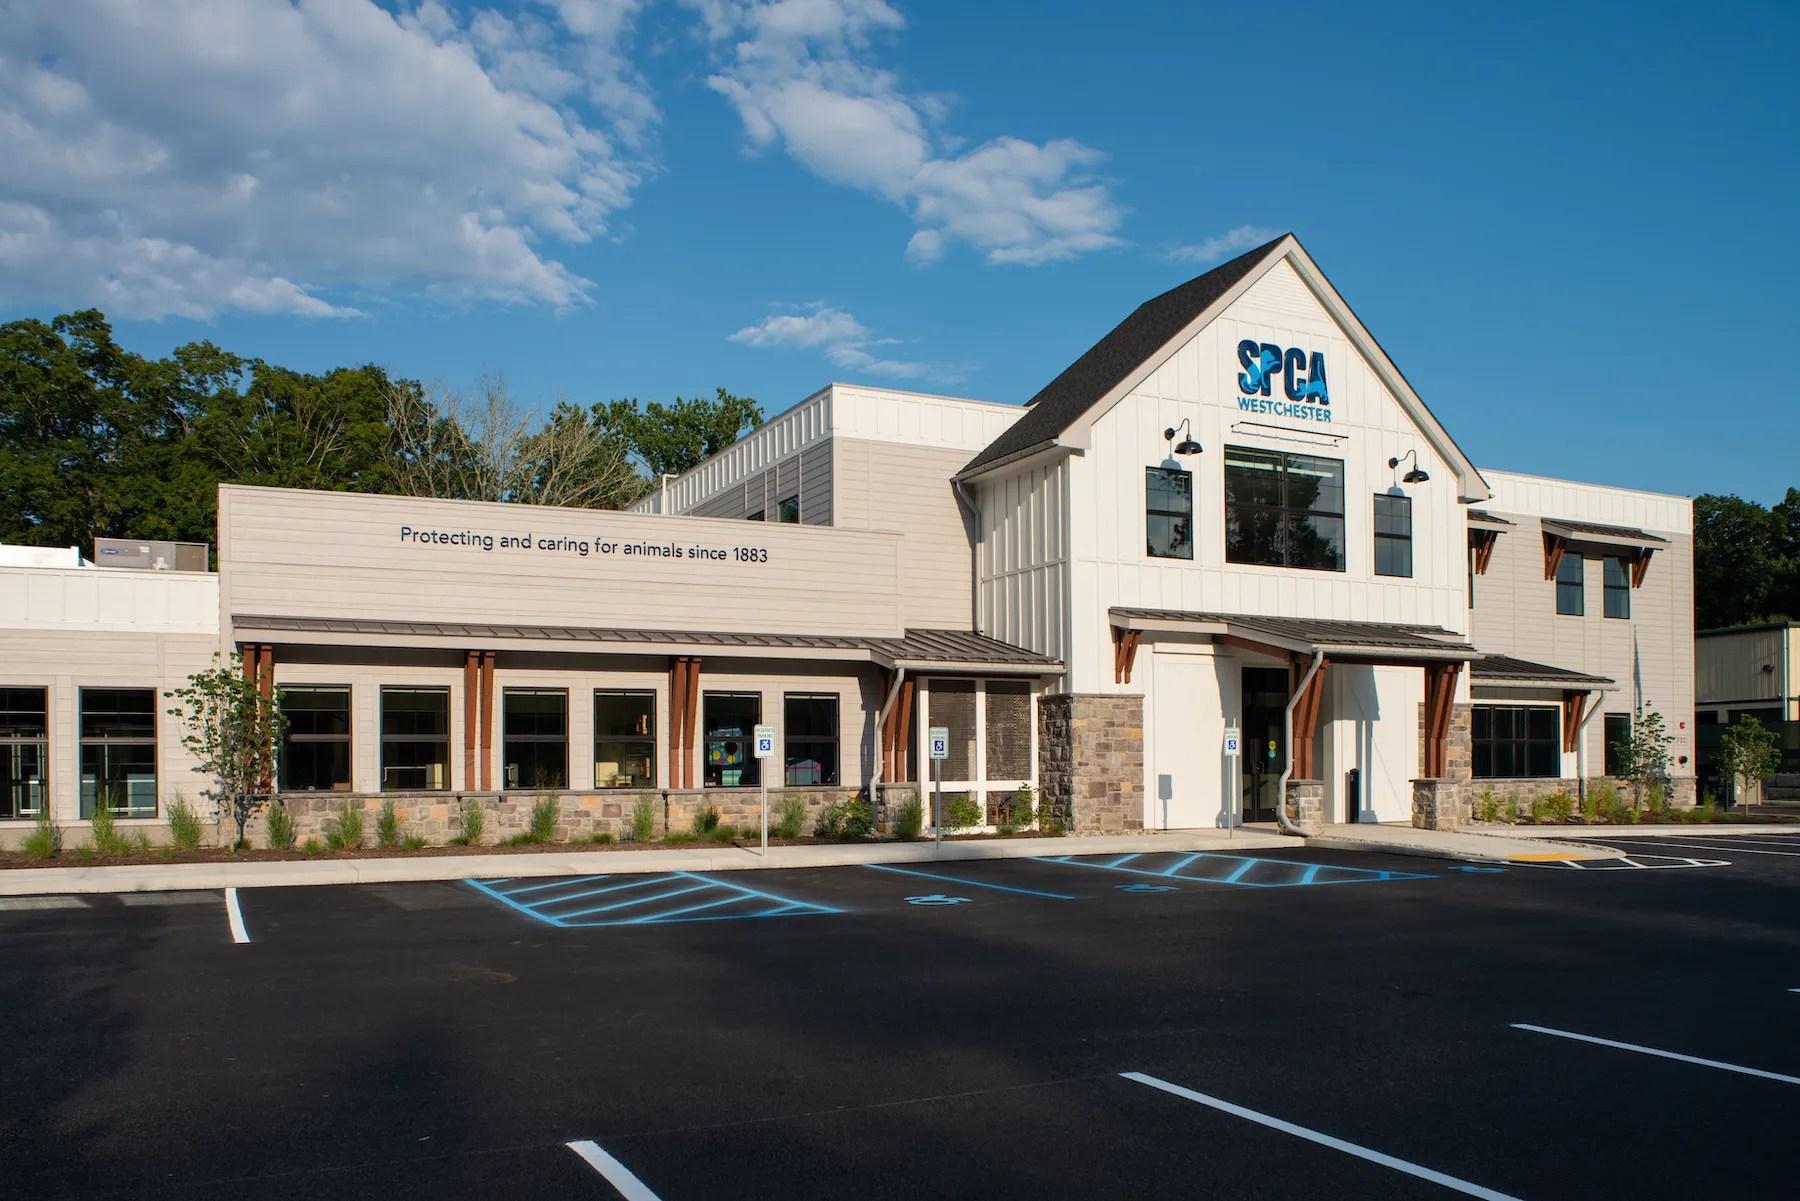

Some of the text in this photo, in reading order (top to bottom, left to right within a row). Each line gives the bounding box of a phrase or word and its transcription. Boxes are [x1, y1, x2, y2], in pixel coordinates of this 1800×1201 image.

[1237, 339, 1329, 405] SPCA
[1237, 396, 1332, 422] WESTCHESTER
[400, 526, 768, 563] Protecting and caring for animals since 1883
